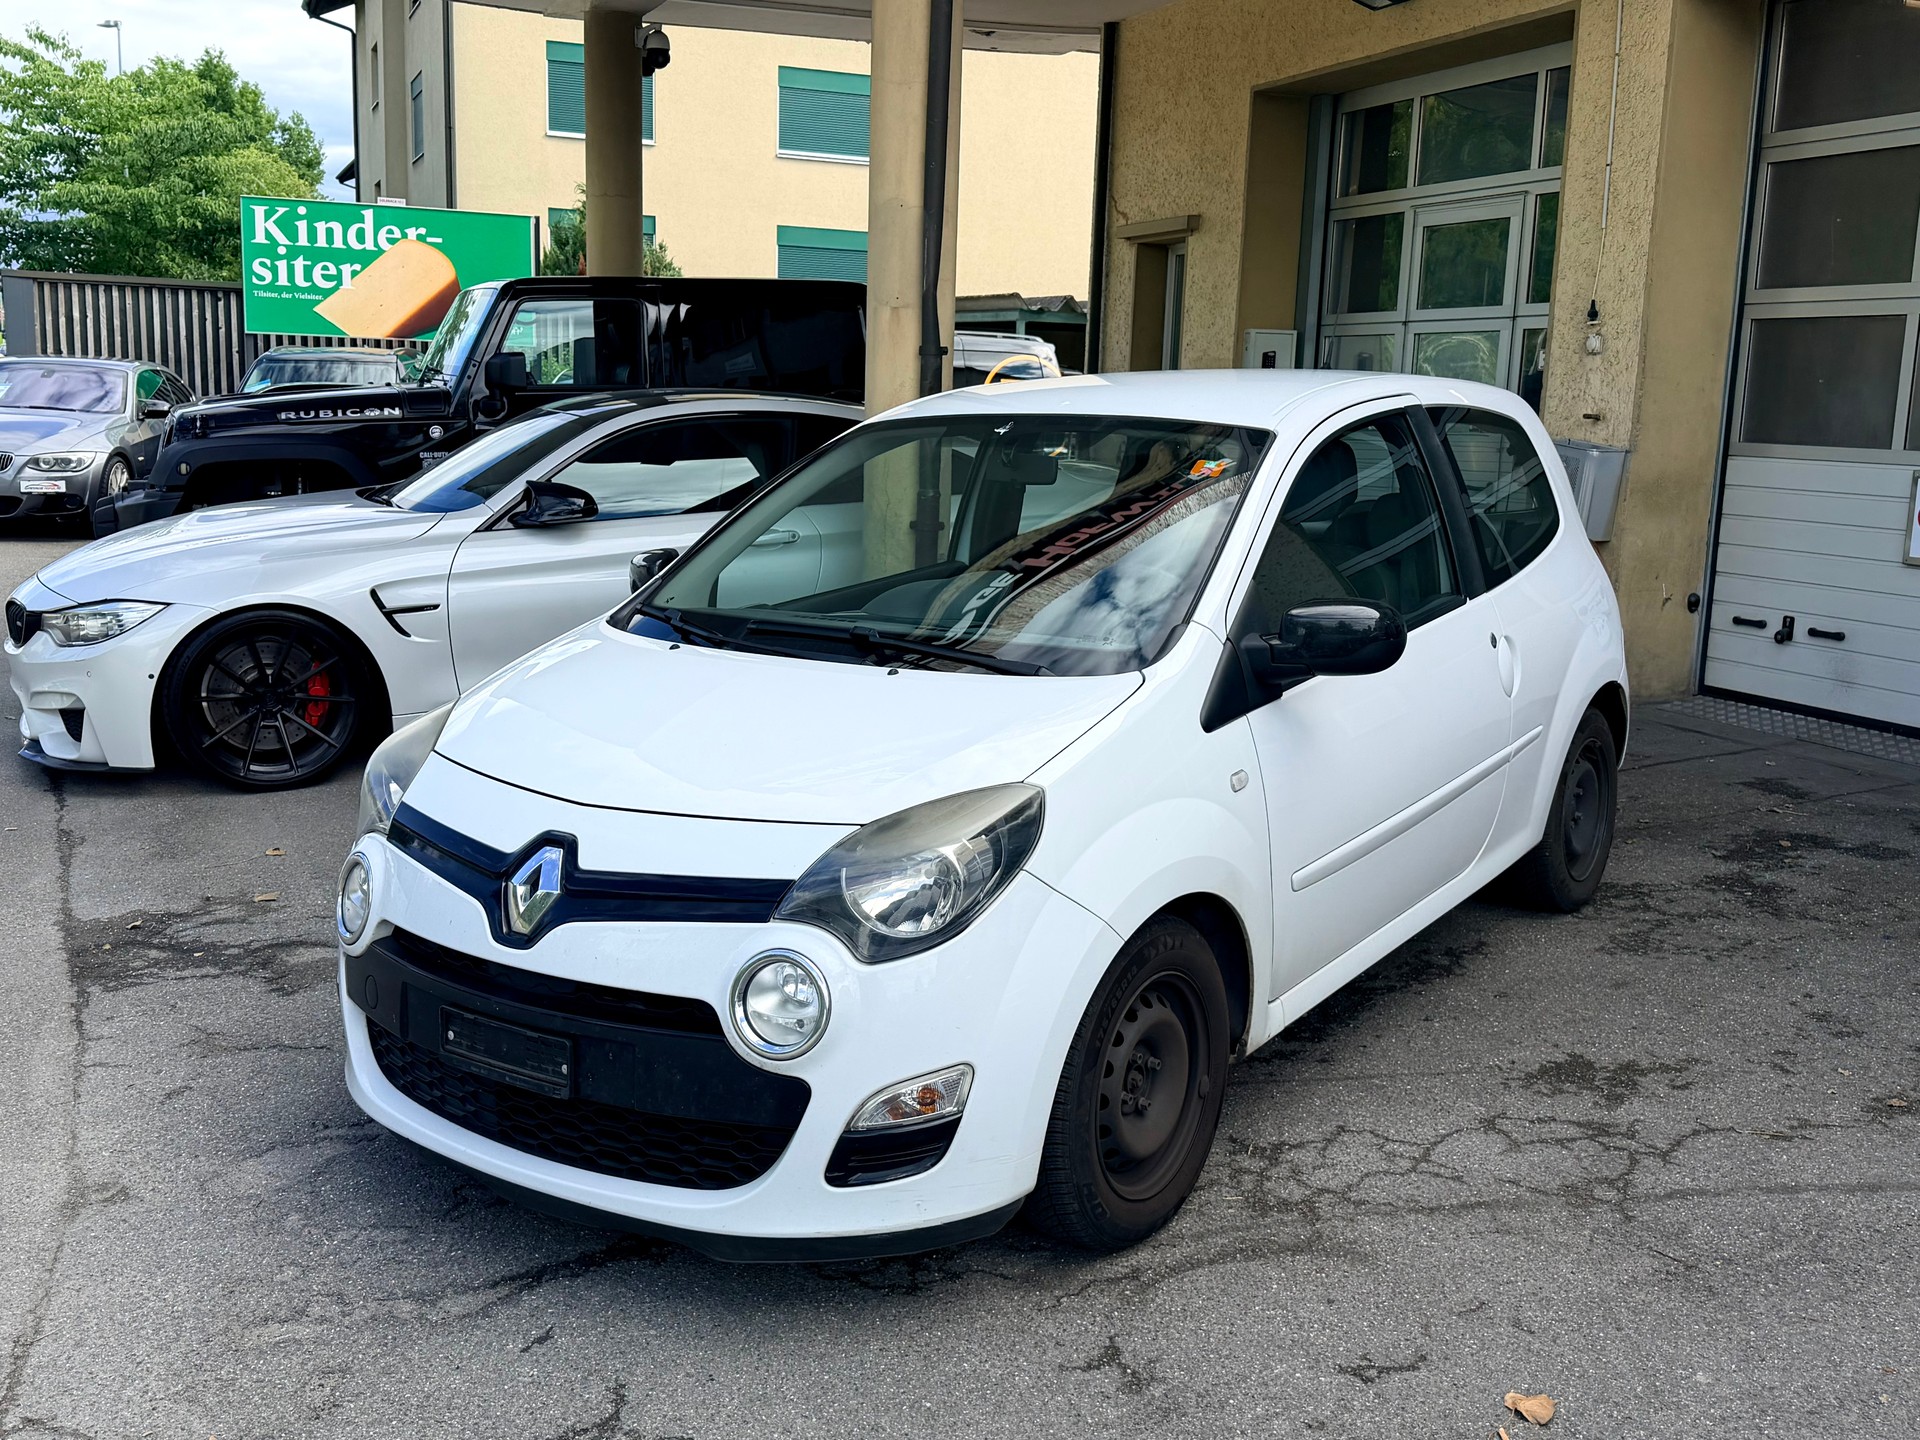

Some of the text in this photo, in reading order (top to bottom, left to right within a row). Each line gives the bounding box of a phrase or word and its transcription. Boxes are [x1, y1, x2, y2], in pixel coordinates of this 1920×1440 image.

[250, 205, 443, 251] Kinder-
[252, 290, 325, 300] Tilsiter, der Vielsiter.
[280, 407, 400, 420] RUBICON
